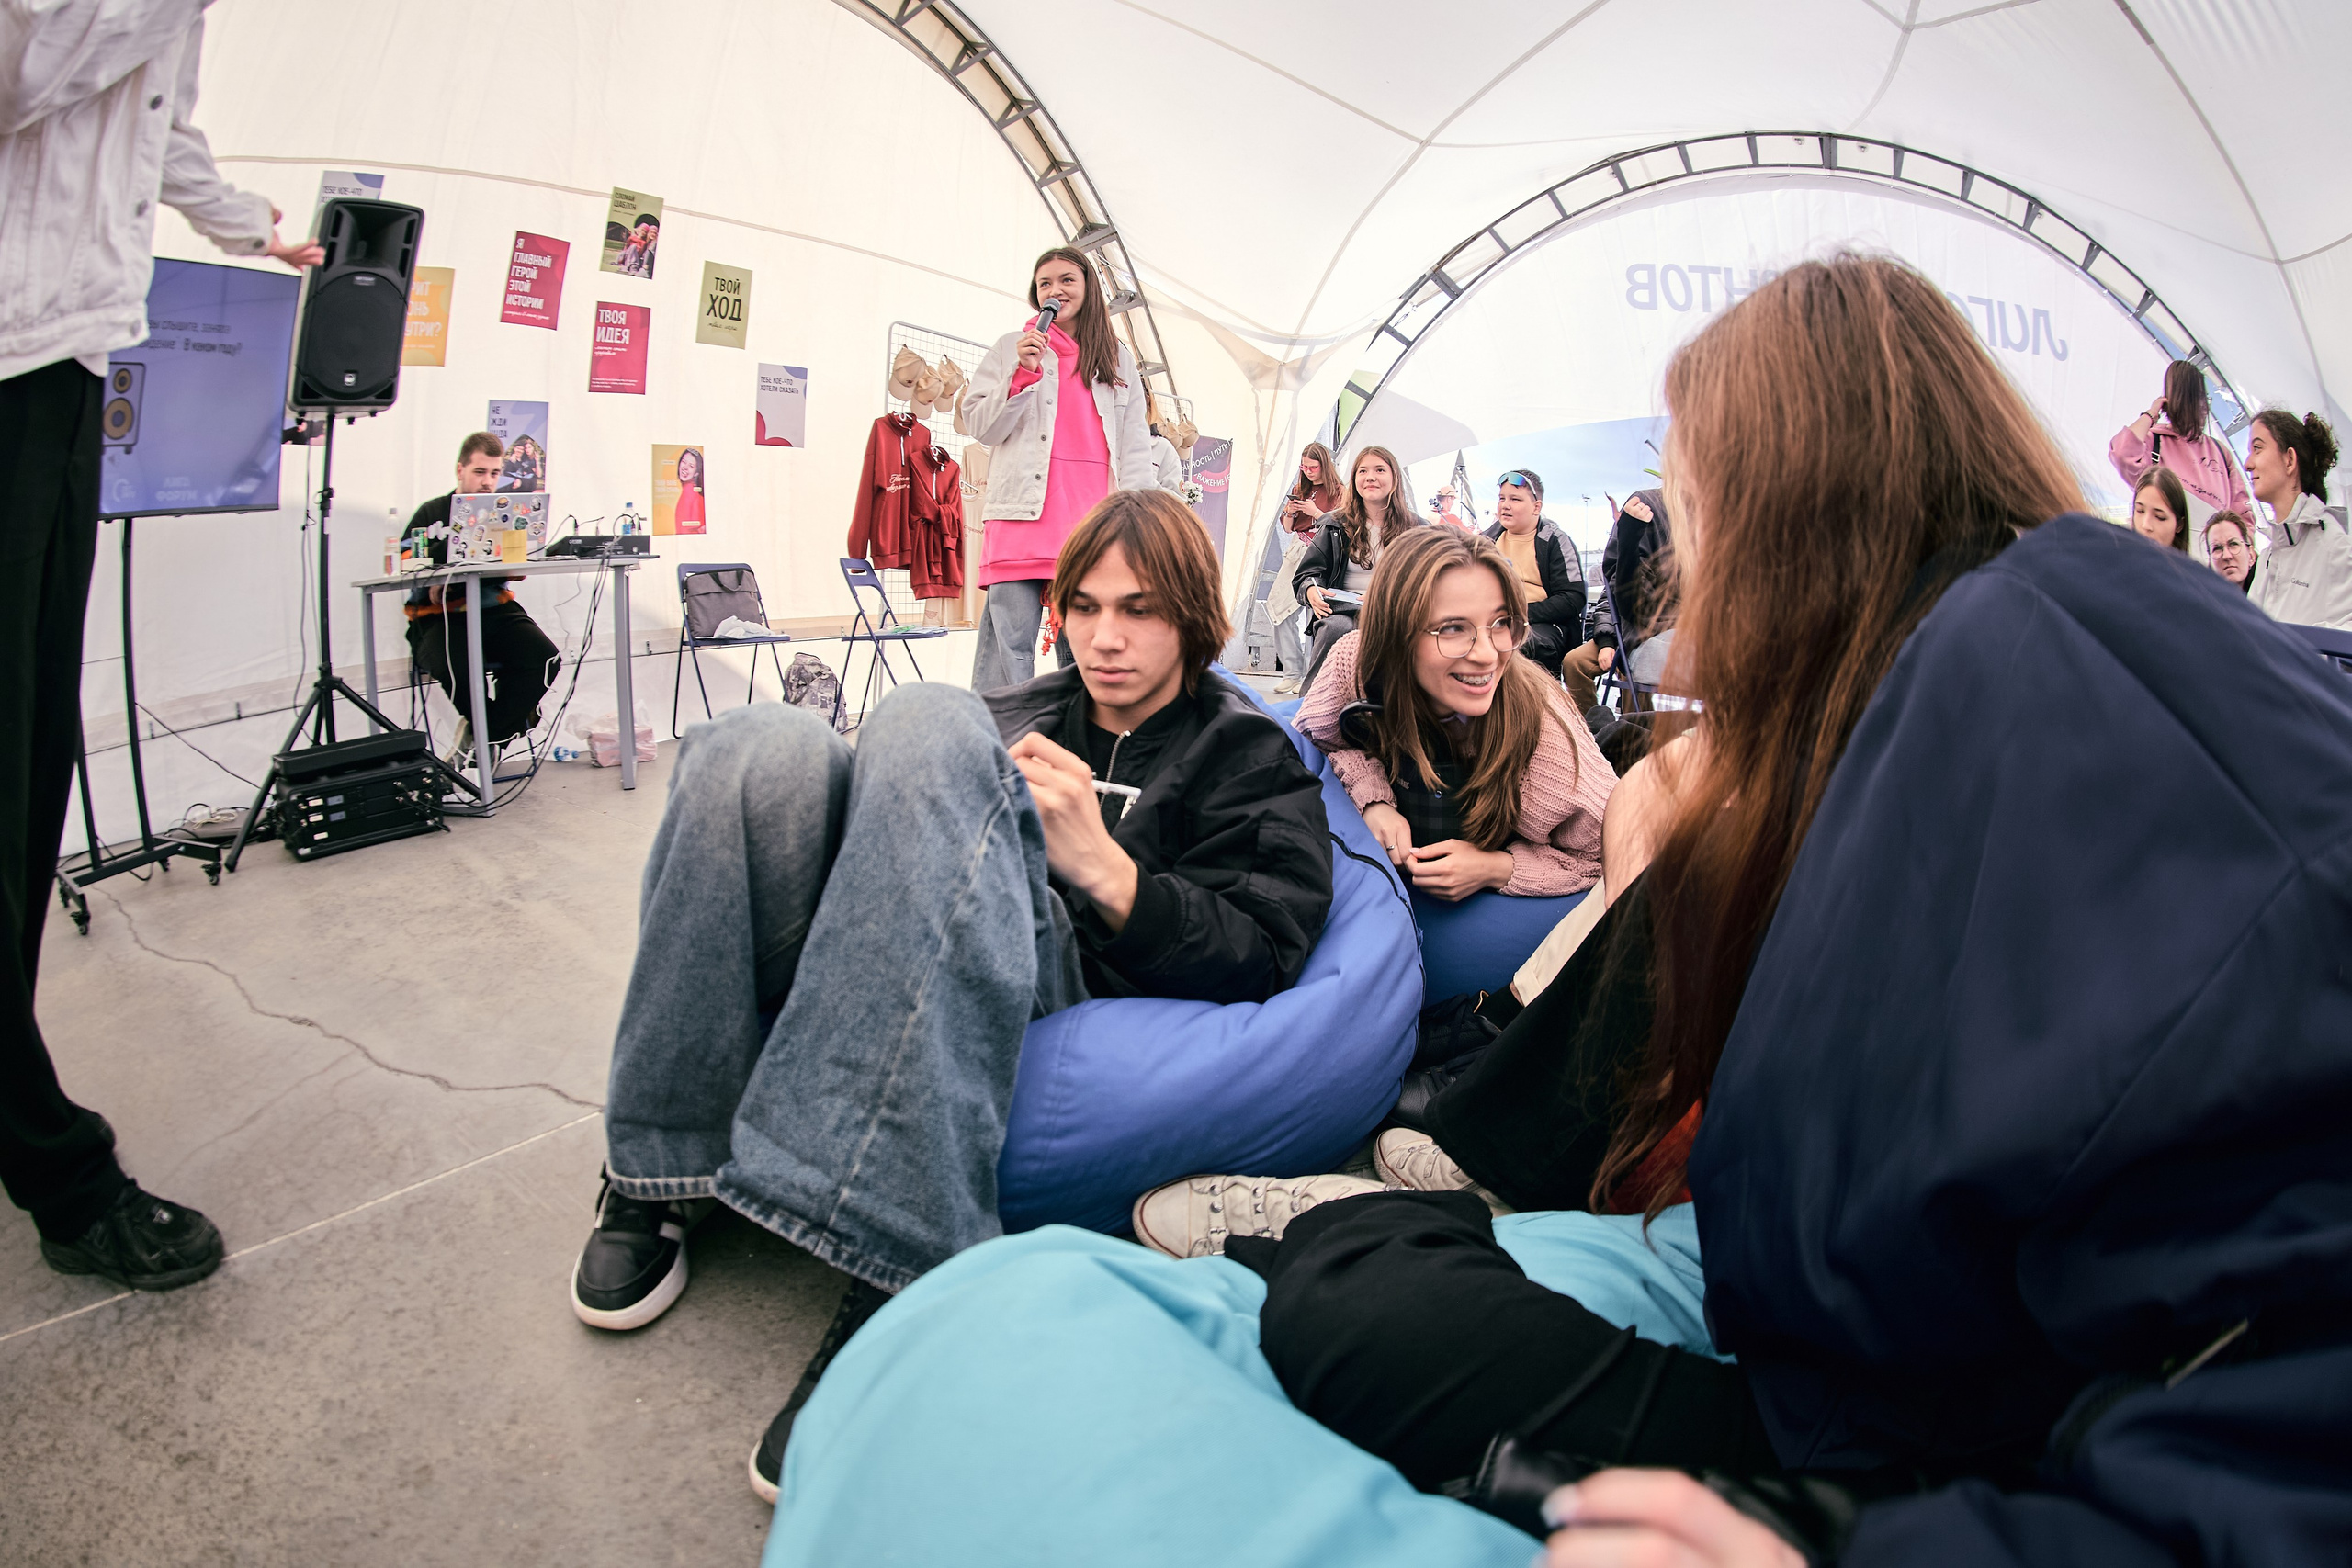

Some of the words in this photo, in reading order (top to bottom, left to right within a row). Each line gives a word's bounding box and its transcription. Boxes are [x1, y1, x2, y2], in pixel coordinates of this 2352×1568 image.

[614, 199, 637, 210] ШАБЛОН
[515, 238, 525, 249] Я
[514, 251, 552, 268] ГЛАВНЫЙ
[511, 265, 538, 279] ГЕРОЙ
[508, 279, 531, 293] ЭТОЙ
[715, 276, 741, 295] ТВОЙ
[408, 300, 429, 317] ОНЬ
[505, 294, 544, 310] ИСТОРИИ
[706, 294, 741, 321] ХОД
[598, 309, 627, 325] ТВОЯ
[404, 321, 442, 337] УТРИ?
[595, 326, 630, 344] ИДЕЯ
[491, 405, 501, 414] НЕ
[1214, 443, 1228, 457] ПУТЬ
